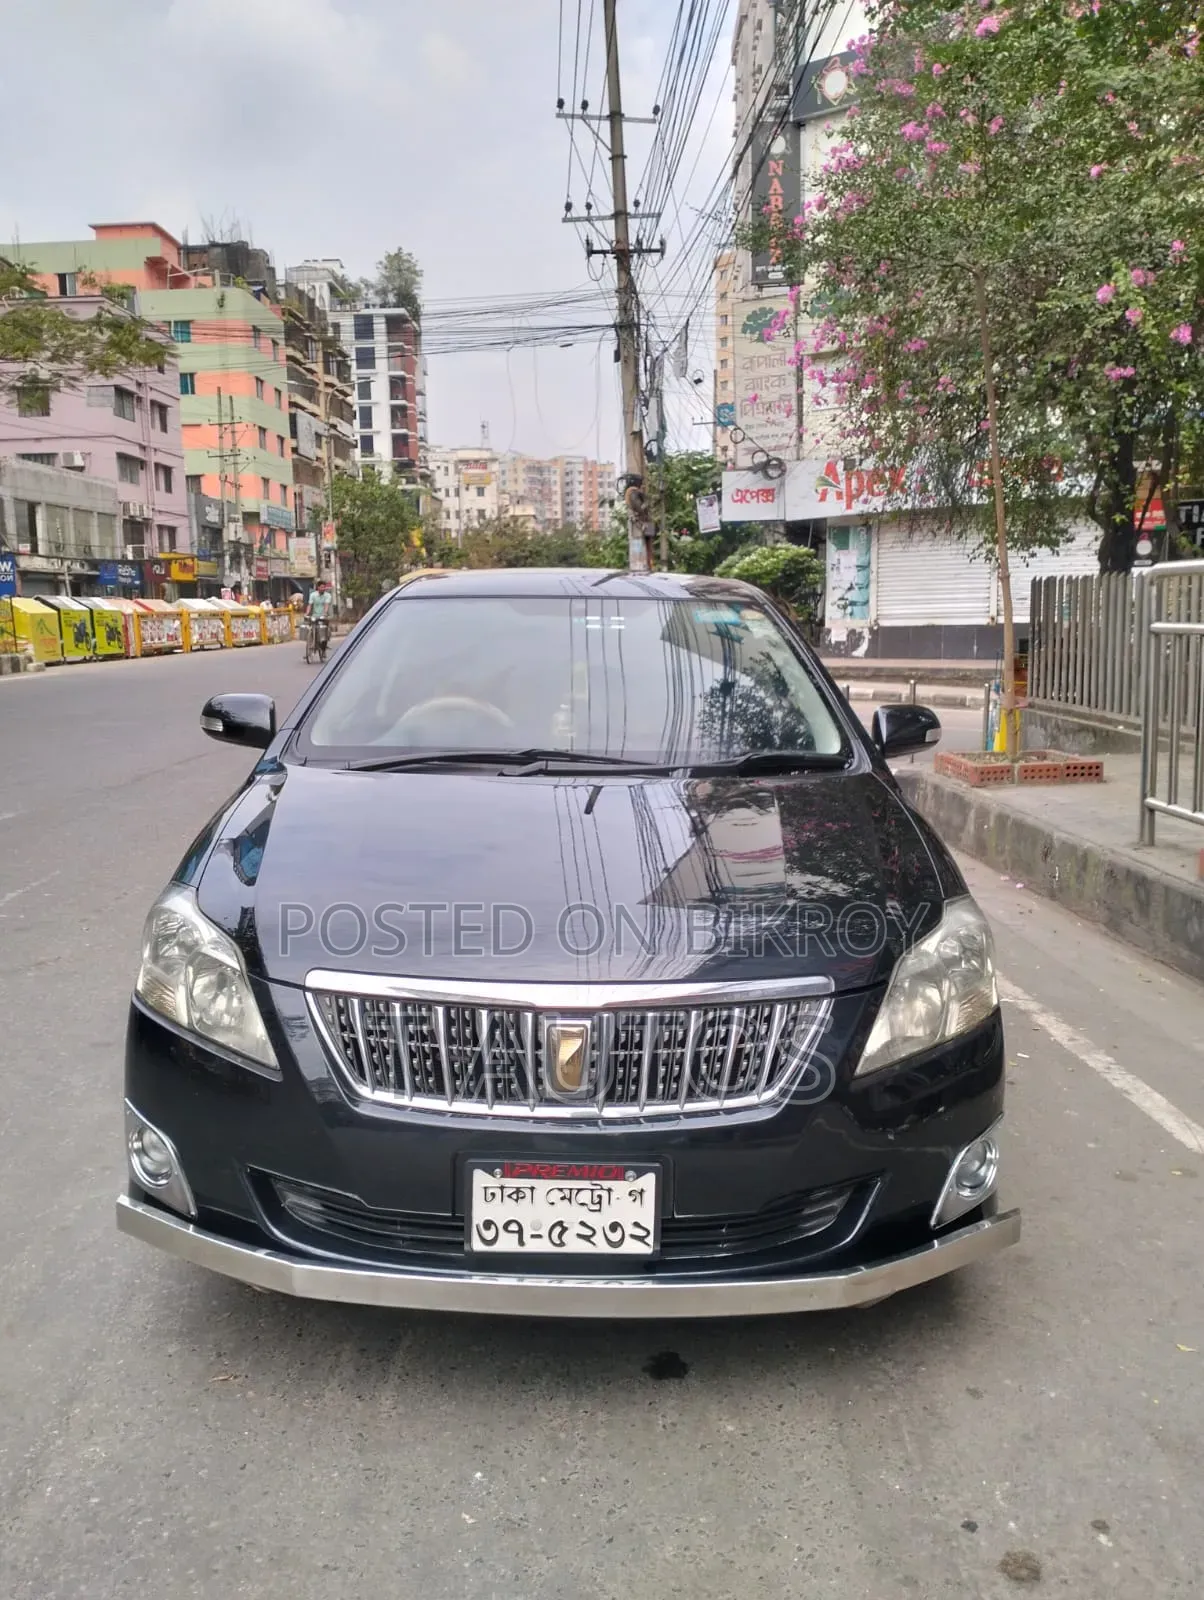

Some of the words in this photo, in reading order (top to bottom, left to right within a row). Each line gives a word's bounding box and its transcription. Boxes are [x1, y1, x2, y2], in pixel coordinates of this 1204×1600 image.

[510, 1162, 618, 1179] PREMIO
[483, 1185, 536, 1204] ঢাকা
[475, 1218, 651, 1249] ৩৭-৫২৩২
